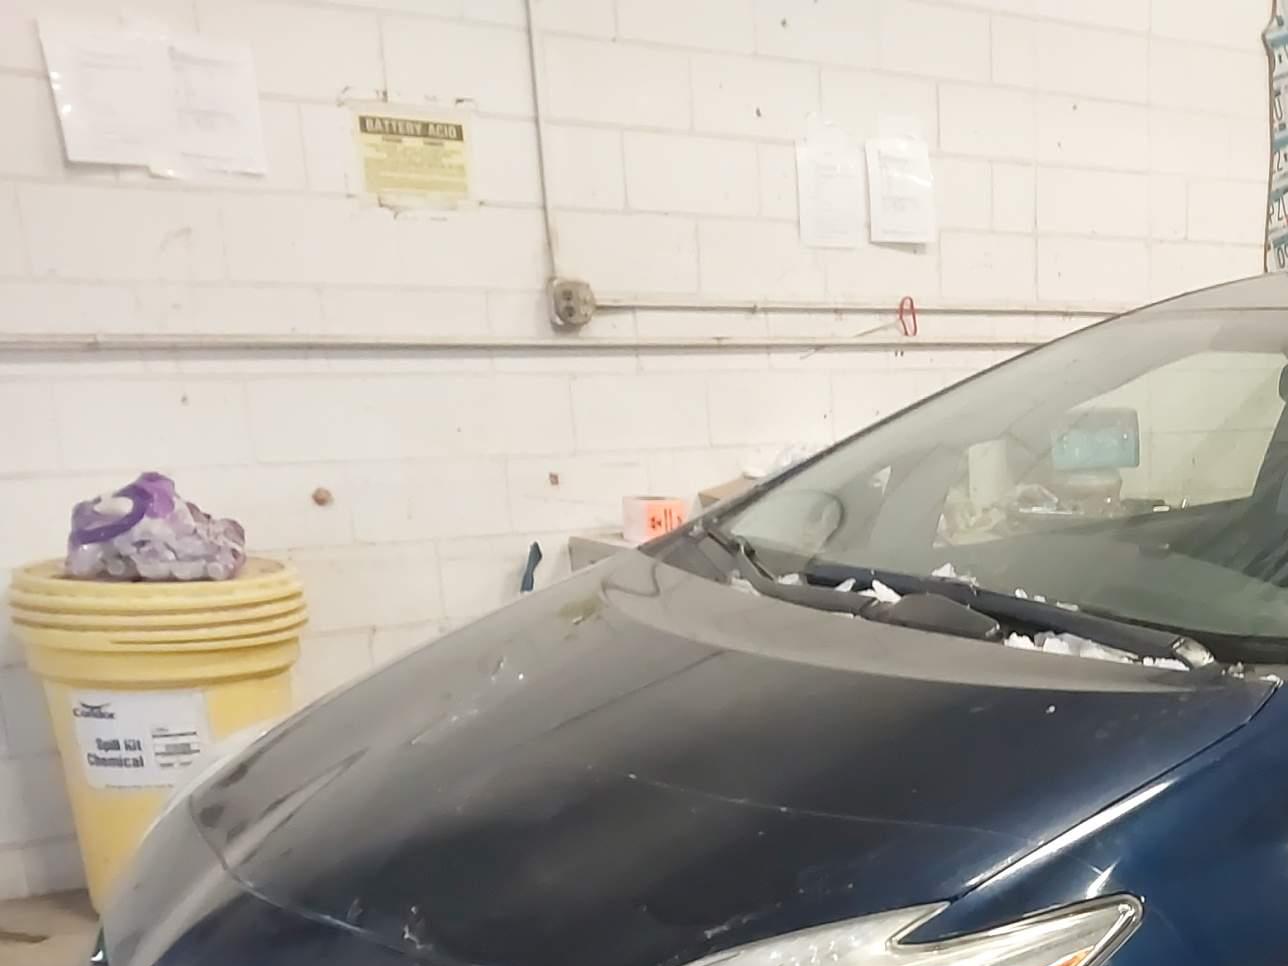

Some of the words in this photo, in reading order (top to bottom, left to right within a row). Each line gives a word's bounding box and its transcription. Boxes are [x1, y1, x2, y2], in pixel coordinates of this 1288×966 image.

[365, 118, 423, 137] BATTERY
[428, 123, 458, 139] ACID
[87, 752, 145, 768] Chemical
